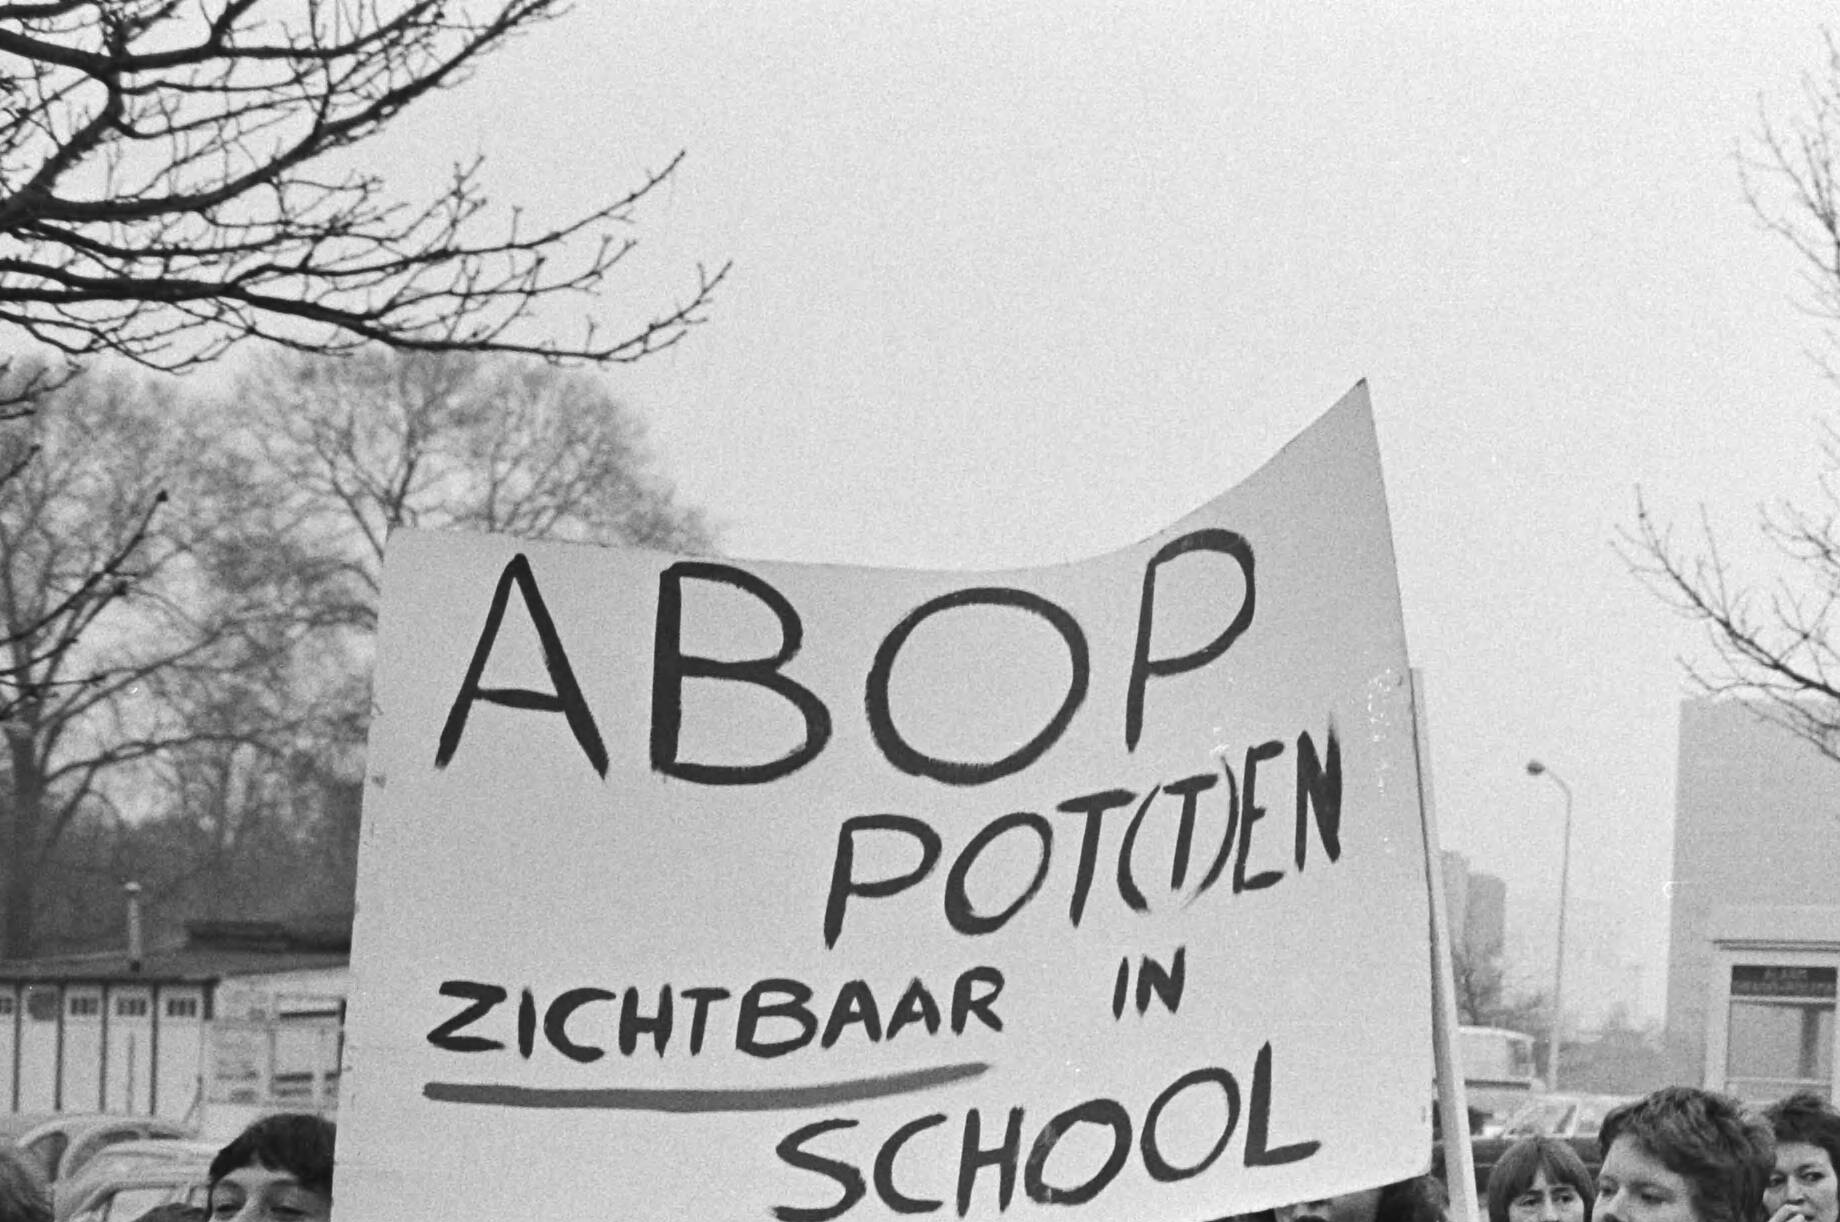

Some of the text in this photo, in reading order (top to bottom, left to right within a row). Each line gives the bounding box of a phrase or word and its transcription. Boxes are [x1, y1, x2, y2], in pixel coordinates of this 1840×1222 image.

[435, 528, 1258, 788] ABOP
[822, 720, 1343, 948] POT(T)EN
[426, 965, 1005, 1064] ZICHTBAAR
[1112, 945, 1187, 1019] IN
